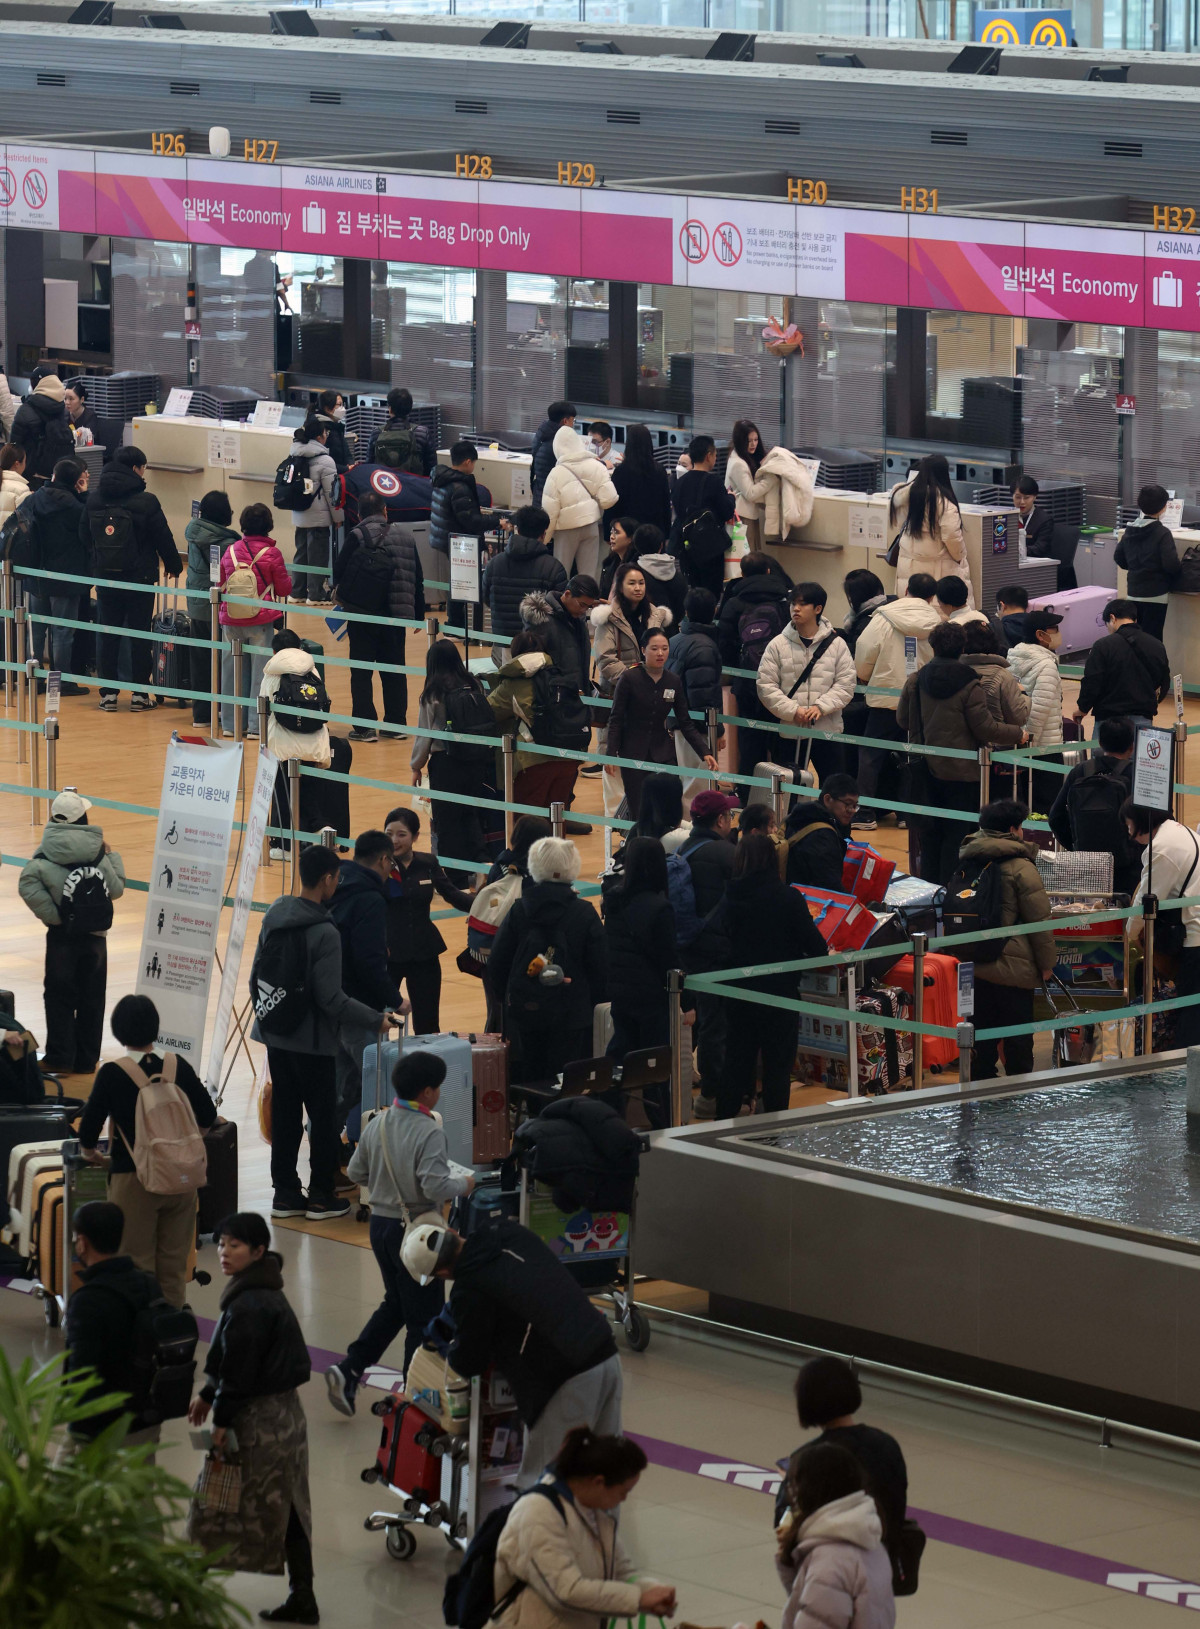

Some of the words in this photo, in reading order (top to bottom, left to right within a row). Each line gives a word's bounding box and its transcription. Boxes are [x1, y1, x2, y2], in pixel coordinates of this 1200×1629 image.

[4, 152, 31, 162] Restricted
[152, 132, 186, 157] H26
[244, 138, 280, 163] H27
[455, 154, 493, 179] H28
[557, 161, 596, 187] H29
[305, 174, 334, 187] ASIANA
[336, 177, 372, 190] AIRLINES
[787, 178, 828, 205] H30
[901, 186, 938, 213] H31
[182, 197, 225, 224] 일반석
[231, 203, 291, 231] Economy
[1153, 205, 1197, 233] H32
[336, 210, 351, 235] 짐
[356, 211, 403, 239] 부치는
[407, 216, 424, 241] 곳
[429, 219, 456, 245] Bag
[460, 222, 494, 248] Drop
[498, 225, 531, 251] Only
[1157, 240, 1193, 255] ASIANA
[1001, 265, 1055, 295] 일반석
[1062, 272, 1138, 304] Economy
[171, 765, 205, 782] 교통약자
[169, 782, 195, 797] 카운터
[197, 786, 230, 804] 이용안내
[256, 987, 287, 1021] didas
[165, 1038, 192, 1050] AIRLINES
